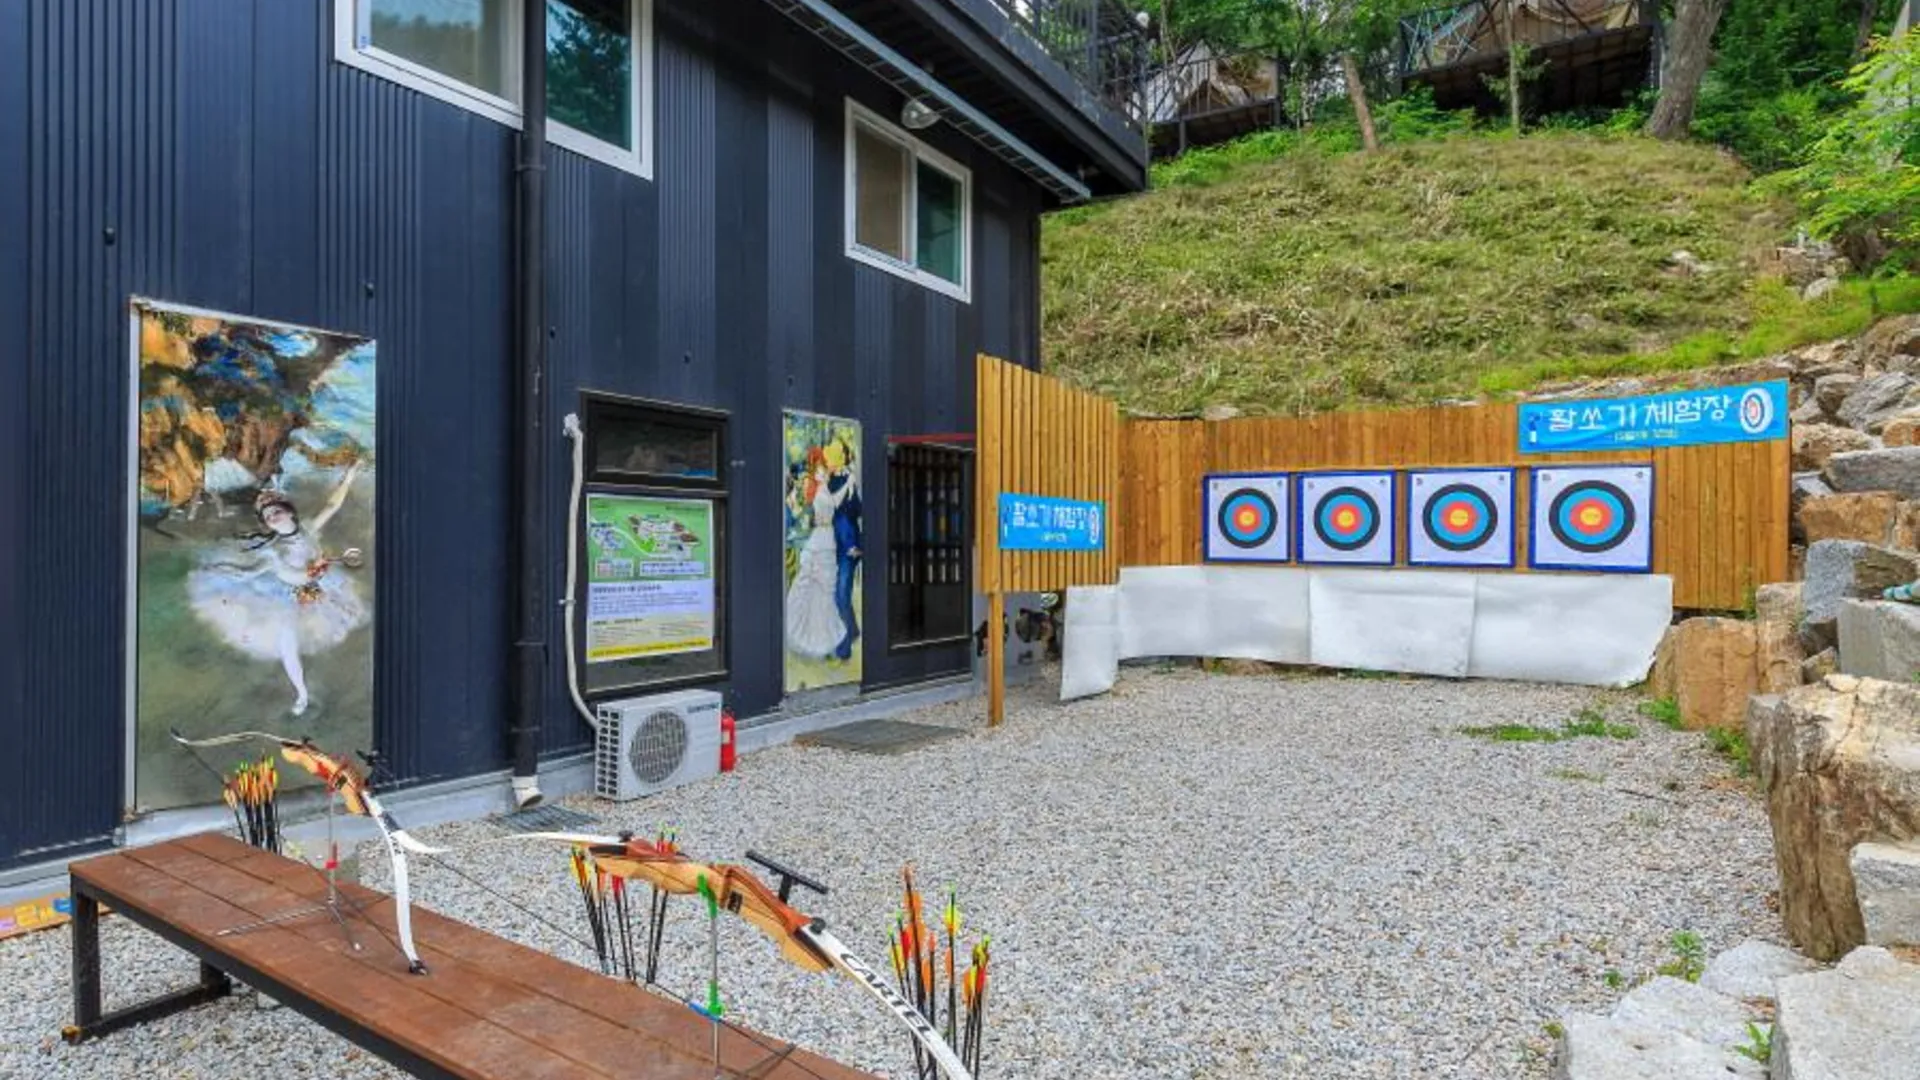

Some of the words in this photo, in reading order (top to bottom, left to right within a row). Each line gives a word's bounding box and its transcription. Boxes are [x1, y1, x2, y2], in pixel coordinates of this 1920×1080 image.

[1549, 405, 1636, 432] 활쏘기
[1643, 394, 1733, 424] 체험장
[840, 952, 932, 1042] CARTEL
